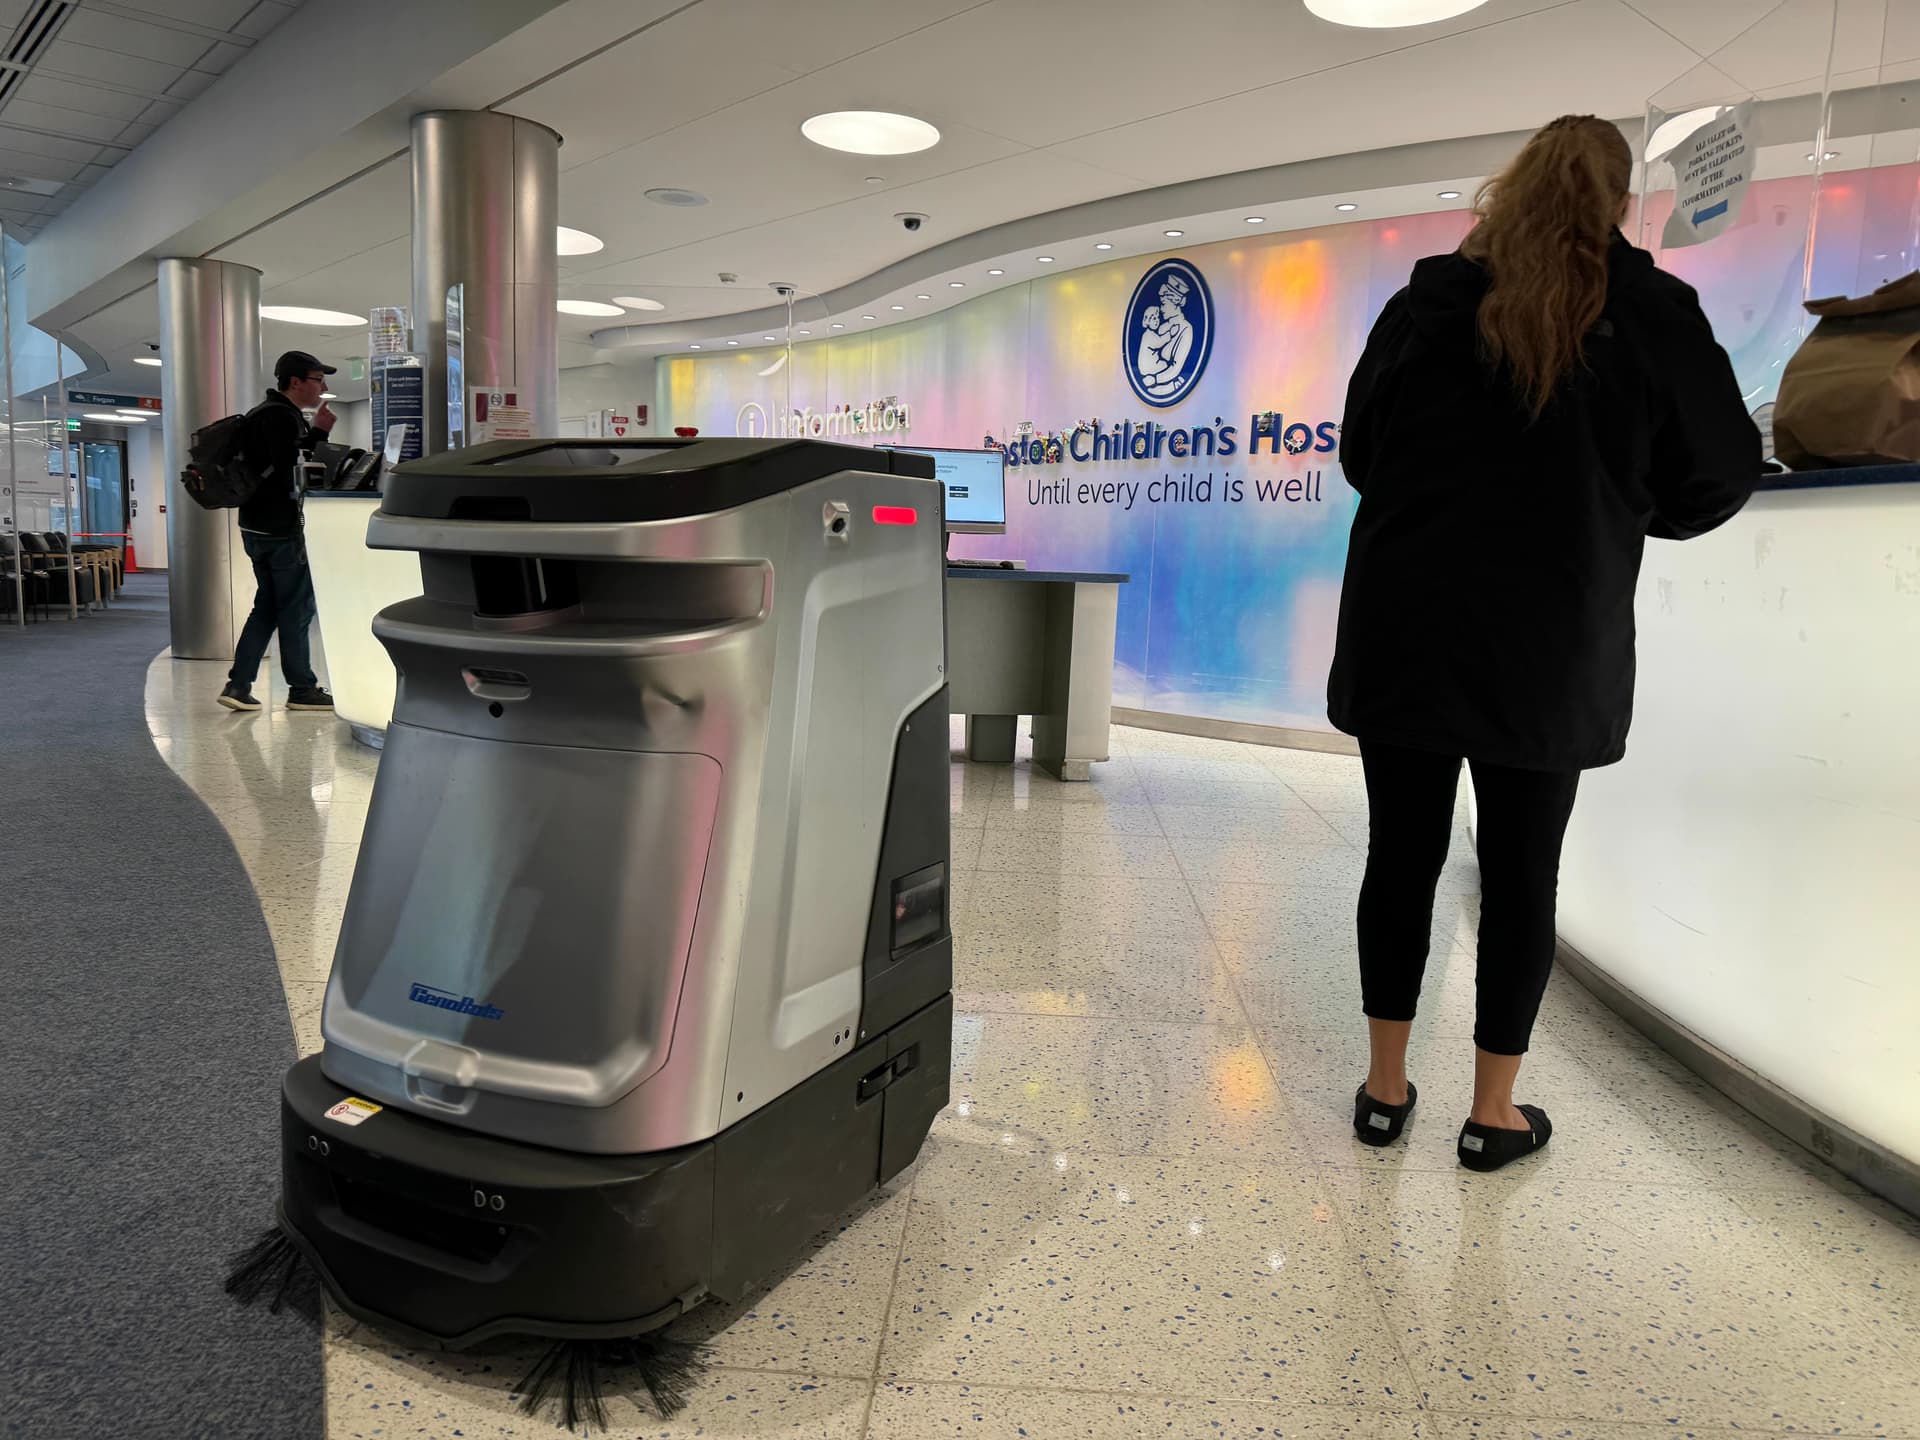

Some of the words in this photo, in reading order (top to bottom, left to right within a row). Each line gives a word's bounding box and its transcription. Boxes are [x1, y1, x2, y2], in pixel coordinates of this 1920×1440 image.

[1070, 416, 1236, 462] Children's
[1249, 413, 1336, 455] Hos
[1028, 478, 1070, 505] Until
[1077, 481, 1139, 510] every
[1147, 473, 1213, 503] child
[1223, 472, 1244, 503] is
[1255, 470, 1321, 502] well
